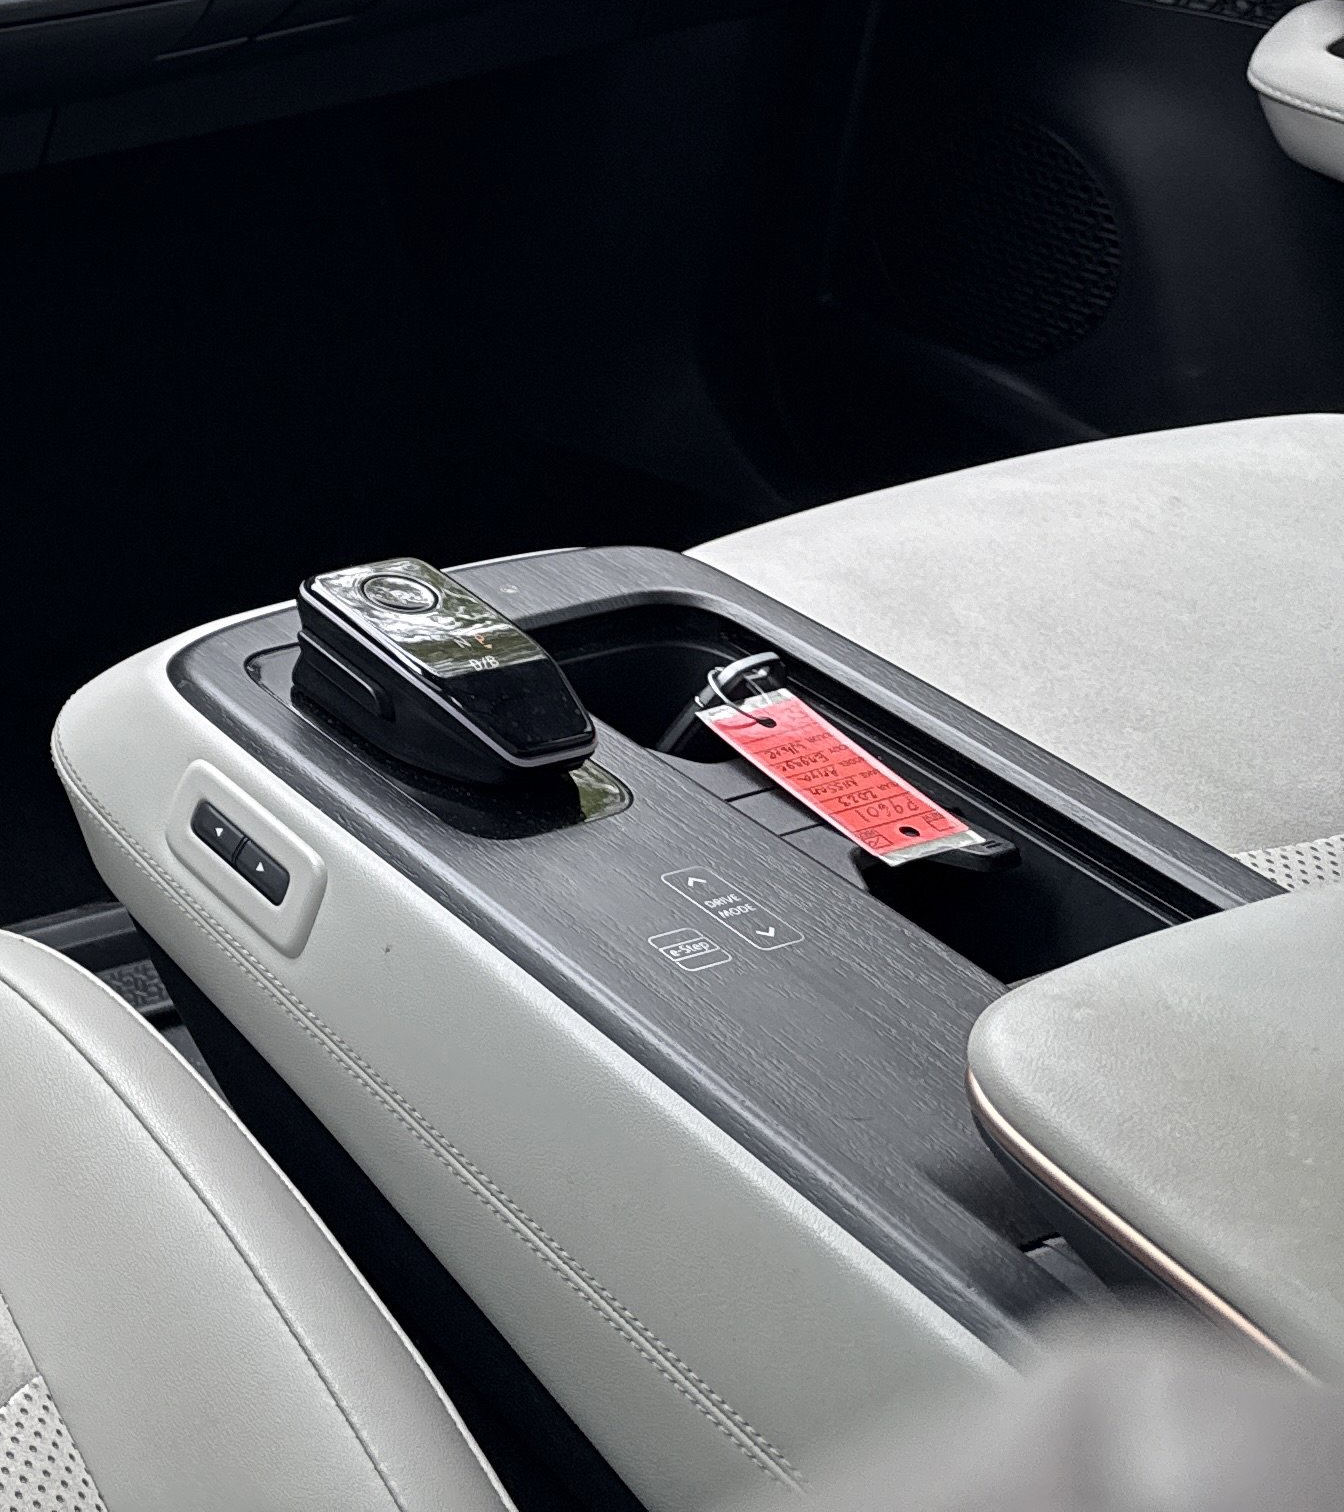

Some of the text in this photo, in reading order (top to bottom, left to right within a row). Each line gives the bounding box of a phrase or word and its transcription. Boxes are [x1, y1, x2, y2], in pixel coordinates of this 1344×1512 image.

[704, 893, 742, 909] DRIVE
[717, 903, 757, 919] MODE
[669, 941, 710, 957] e-Step
